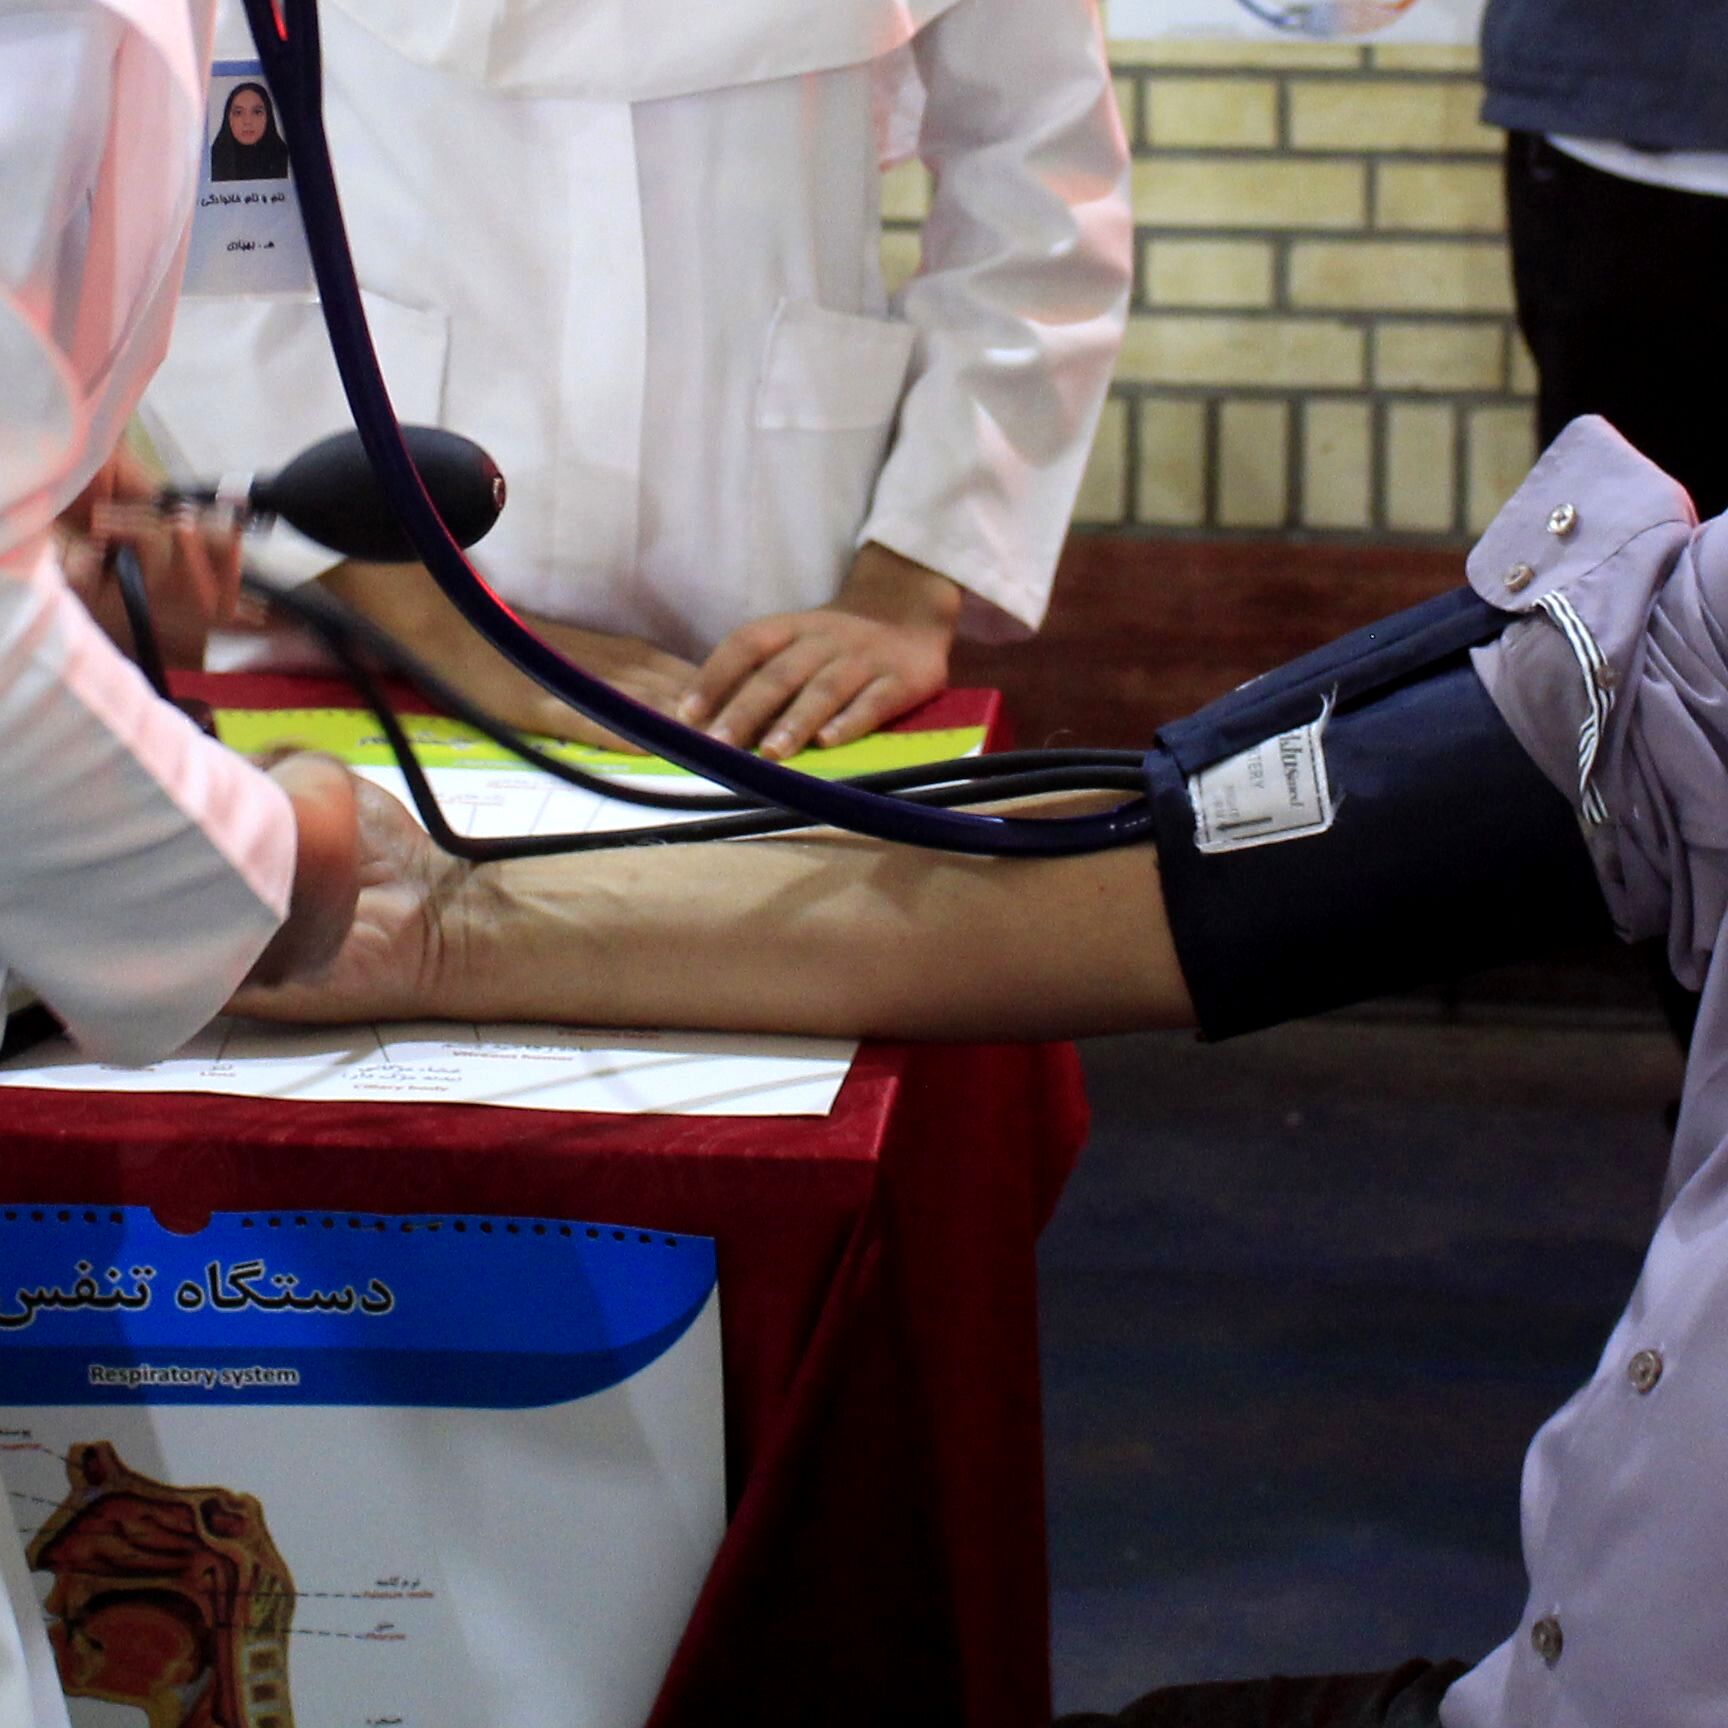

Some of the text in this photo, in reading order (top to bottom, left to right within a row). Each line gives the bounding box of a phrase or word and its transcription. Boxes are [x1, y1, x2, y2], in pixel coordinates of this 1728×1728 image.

[174, 1259, 395, 1316] دستگاه
[87, 1361, 301, 1389] Respiratory system
